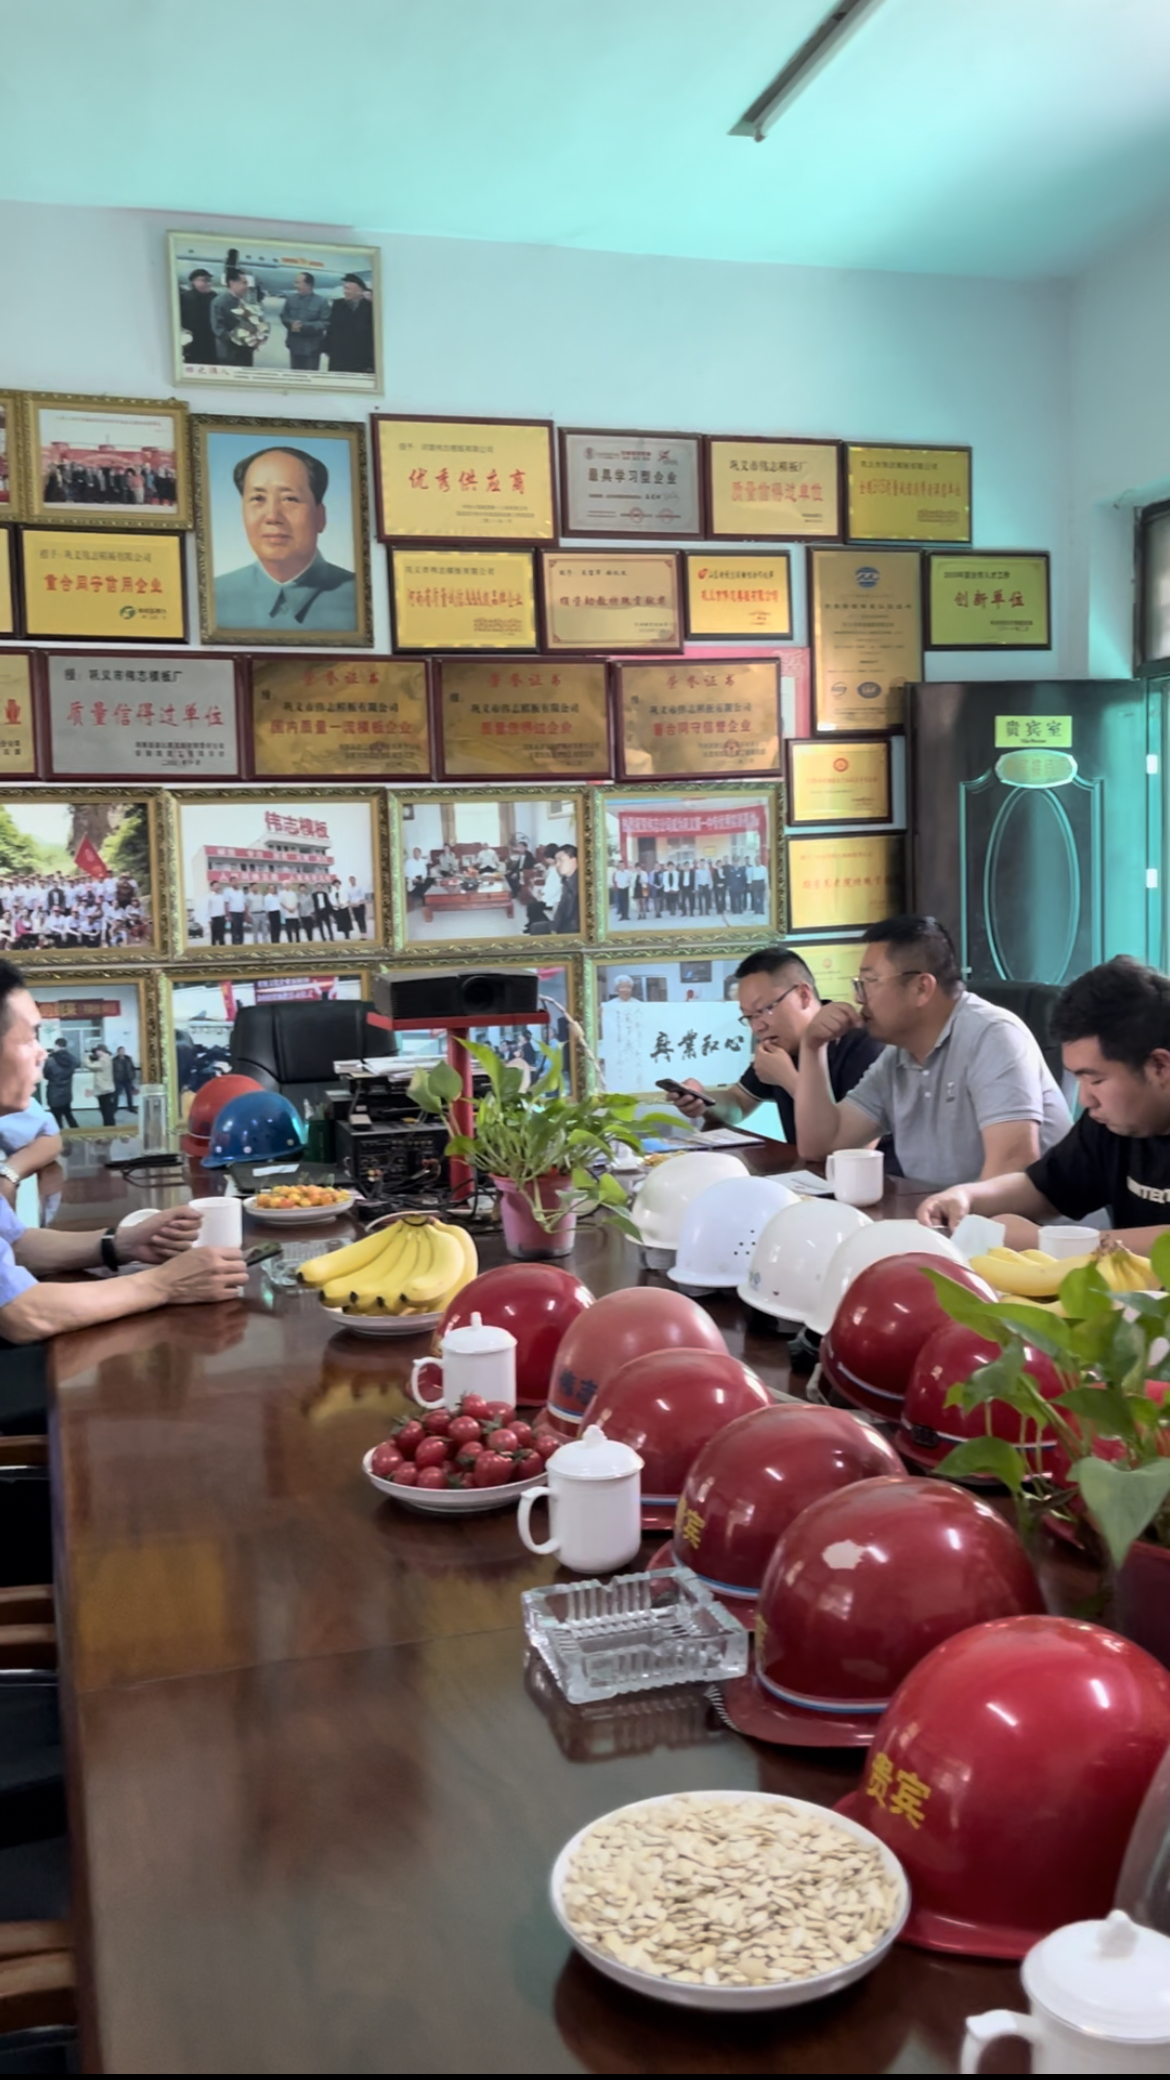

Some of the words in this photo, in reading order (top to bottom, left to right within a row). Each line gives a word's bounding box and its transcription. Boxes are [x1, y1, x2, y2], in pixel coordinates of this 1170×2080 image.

[408, 467, 526, 495] 优秀供应商
[588, 467, 677, 485] 最具学习型企业
[953, 588, 1026, 610] 创新单位
[67, 700, 225, 728] 质量信得过单位
[1006, 720, 1062, 737] 贵宾室
[264, 810, 330, 839] 伟志模板
[865, 1752, 931, 1830] 贵宾
